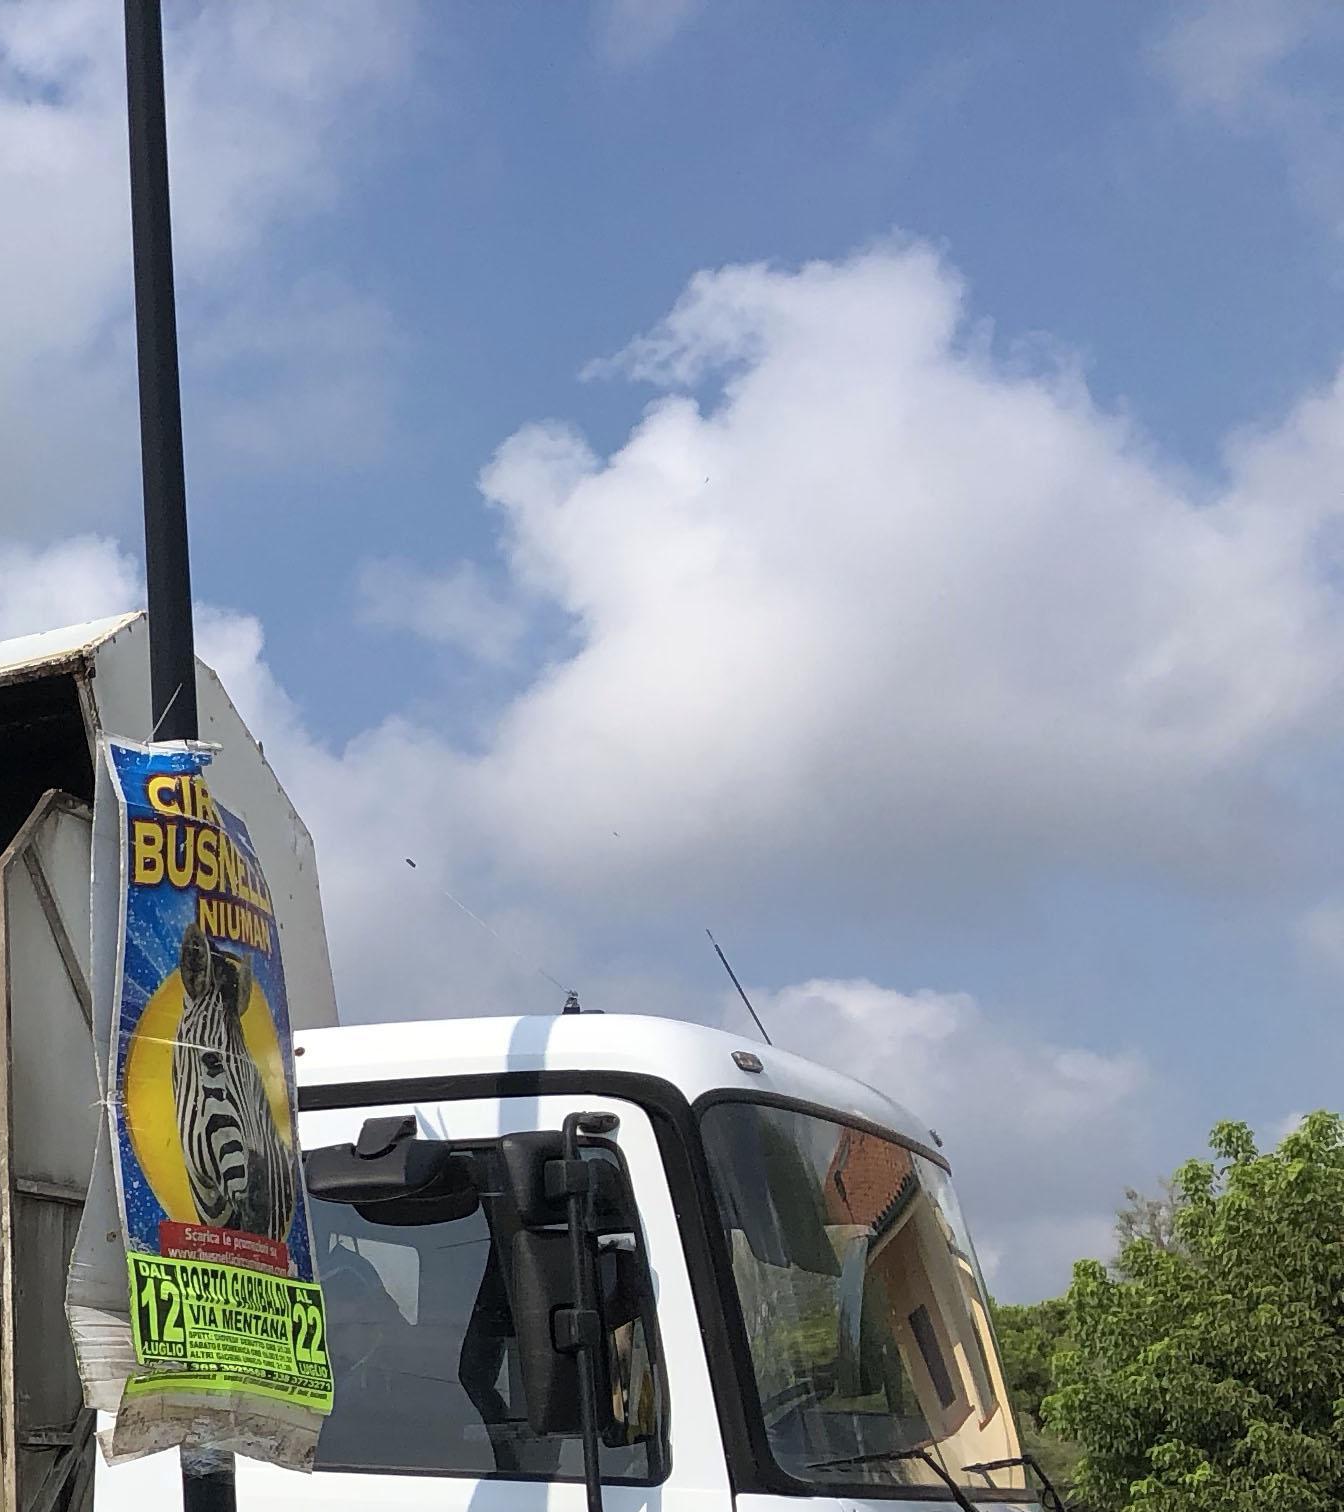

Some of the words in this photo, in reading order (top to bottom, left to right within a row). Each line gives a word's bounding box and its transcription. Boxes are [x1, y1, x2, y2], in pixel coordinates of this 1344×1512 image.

[184, 1227, 220, 1244] Scarica
[222, 1232, 232, 1246] le
[138, 1262, 171, 1281] DAL
[179, 1264, 228, 1304] PORTO
[231, 1271, 291, 1319] GARIBALDI
[295, 1288, 313, 1304] AL
[140, 1278, 186, 1343] 12
[189, 1303, 219, 1329] VIA
[221, 1308, 290, 1342] MENTANA
[292, 1302, 327, 1365] 22
[143, 1340, 184, 1358] LUGLIO
[299, 1360, 329, 1378] LUGLIO
